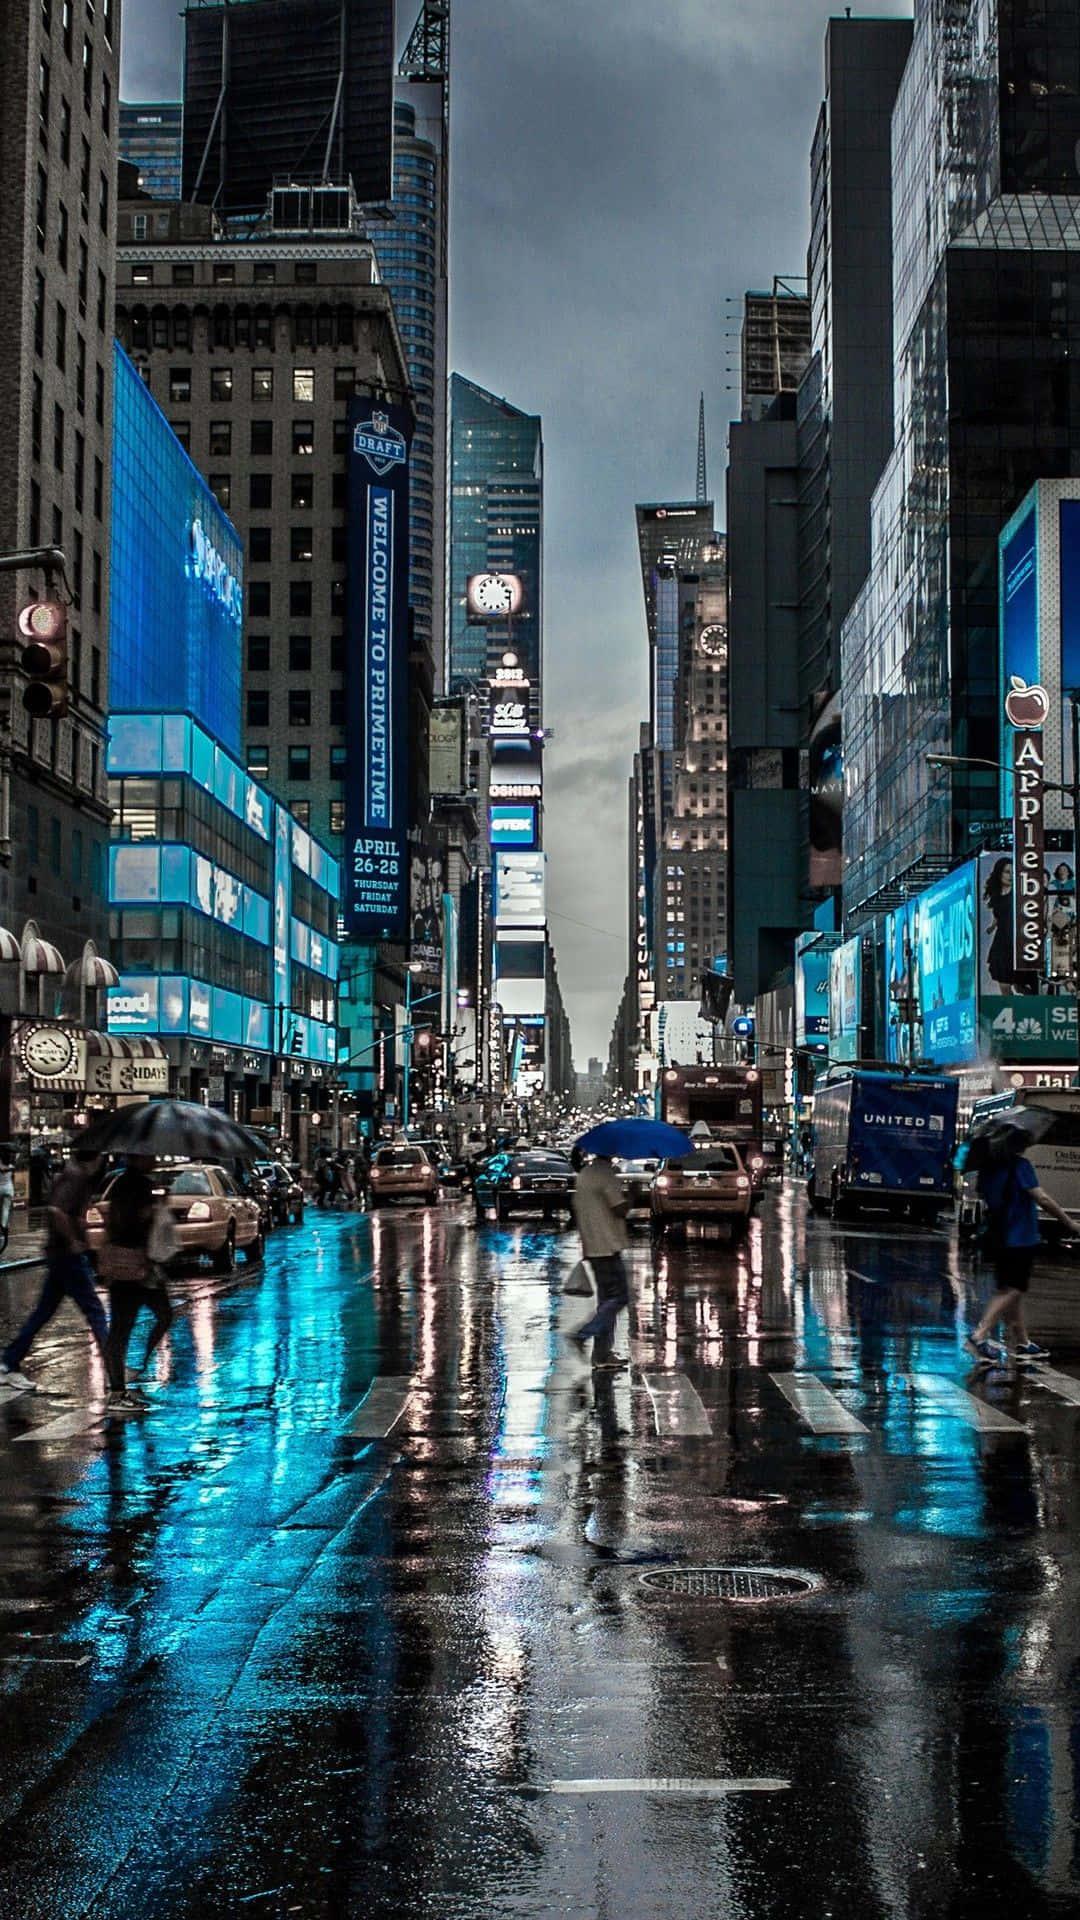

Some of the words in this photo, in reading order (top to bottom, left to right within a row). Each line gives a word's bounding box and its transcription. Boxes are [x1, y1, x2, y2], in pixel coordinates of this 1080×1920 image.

[358, 436, 402, 456] DRAFT
[372, 497, 388, 622] WELCOME
[371, 629, 386, 661] TO
[371, 668, 386, 819] PRIMETIME
[353, 838, 400, 857] APRIL
[354, 858, 399, 875] 26-28
[353, 880, 399, 890] THURSDAY
[361, 891, 392, 902] FRIDAY
[354, 903, 398, 914] SATURDAY
[992, 1008, 1016, 1034] 4
[1051, 1029, 1078, 1041] WE
[132, 1066, 167, 1079] RIDAY'S
[864, 1114, 925, 1127] UNITED
